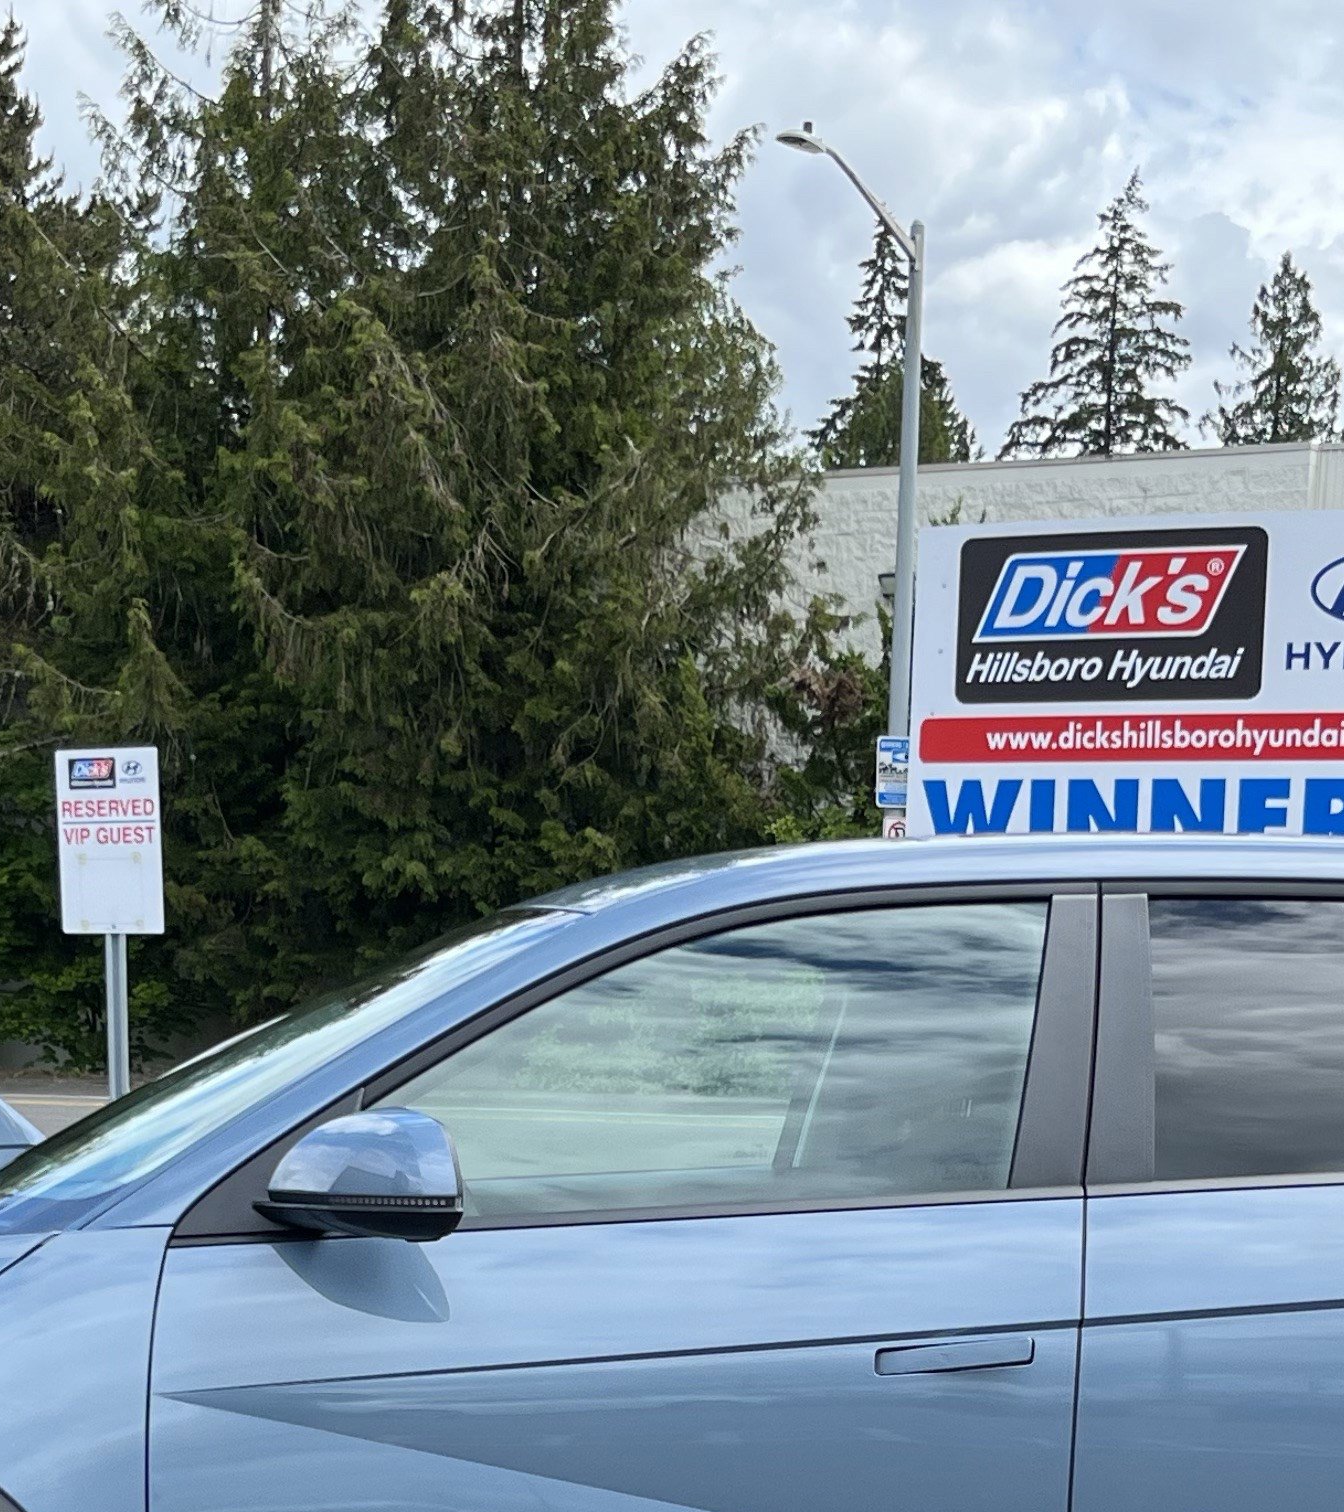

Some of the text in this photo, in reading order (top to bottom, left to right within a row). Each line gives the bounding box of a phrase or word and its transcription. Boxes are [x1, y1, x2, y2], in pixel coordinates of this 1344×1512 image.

[992, 557, 1210, 629] Dick's
[965, 647, 1246, 690] Hillsboro Hyundai
[61, 799, 155, 818] RESERVED
[63, 826, 156, 846] VIP GUEST
